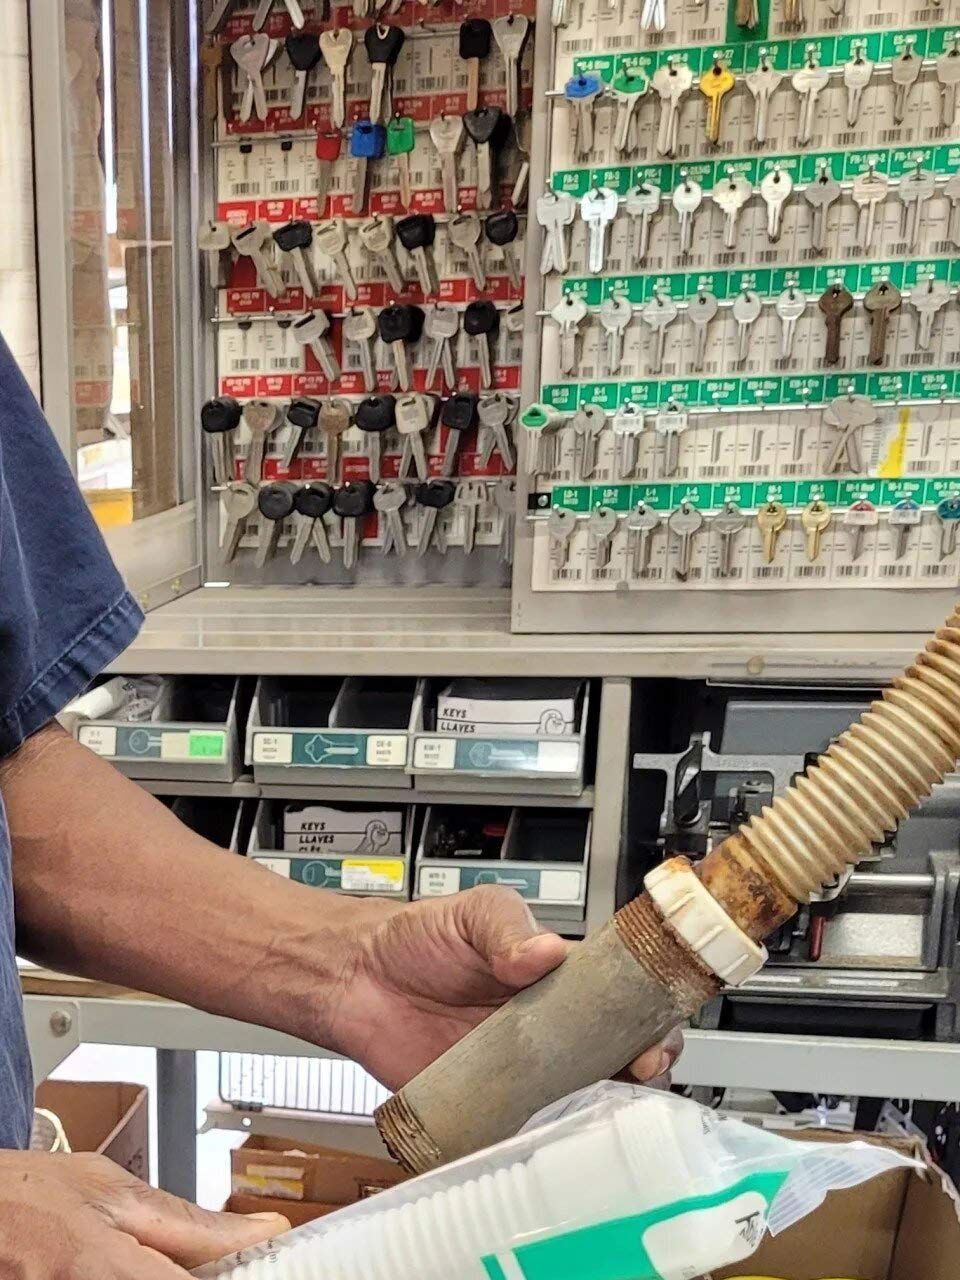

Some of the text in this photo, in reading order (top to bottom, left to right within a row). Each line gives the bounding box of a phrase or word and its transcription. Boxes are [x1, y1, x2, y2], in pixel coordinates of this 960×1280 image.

[442, 708, 467, 719] KEYS
[440, 722, 476, 733] LLAVES
[300, 822, 326, 831] KEYS
[299, 835, 335, 844] LLAVES
